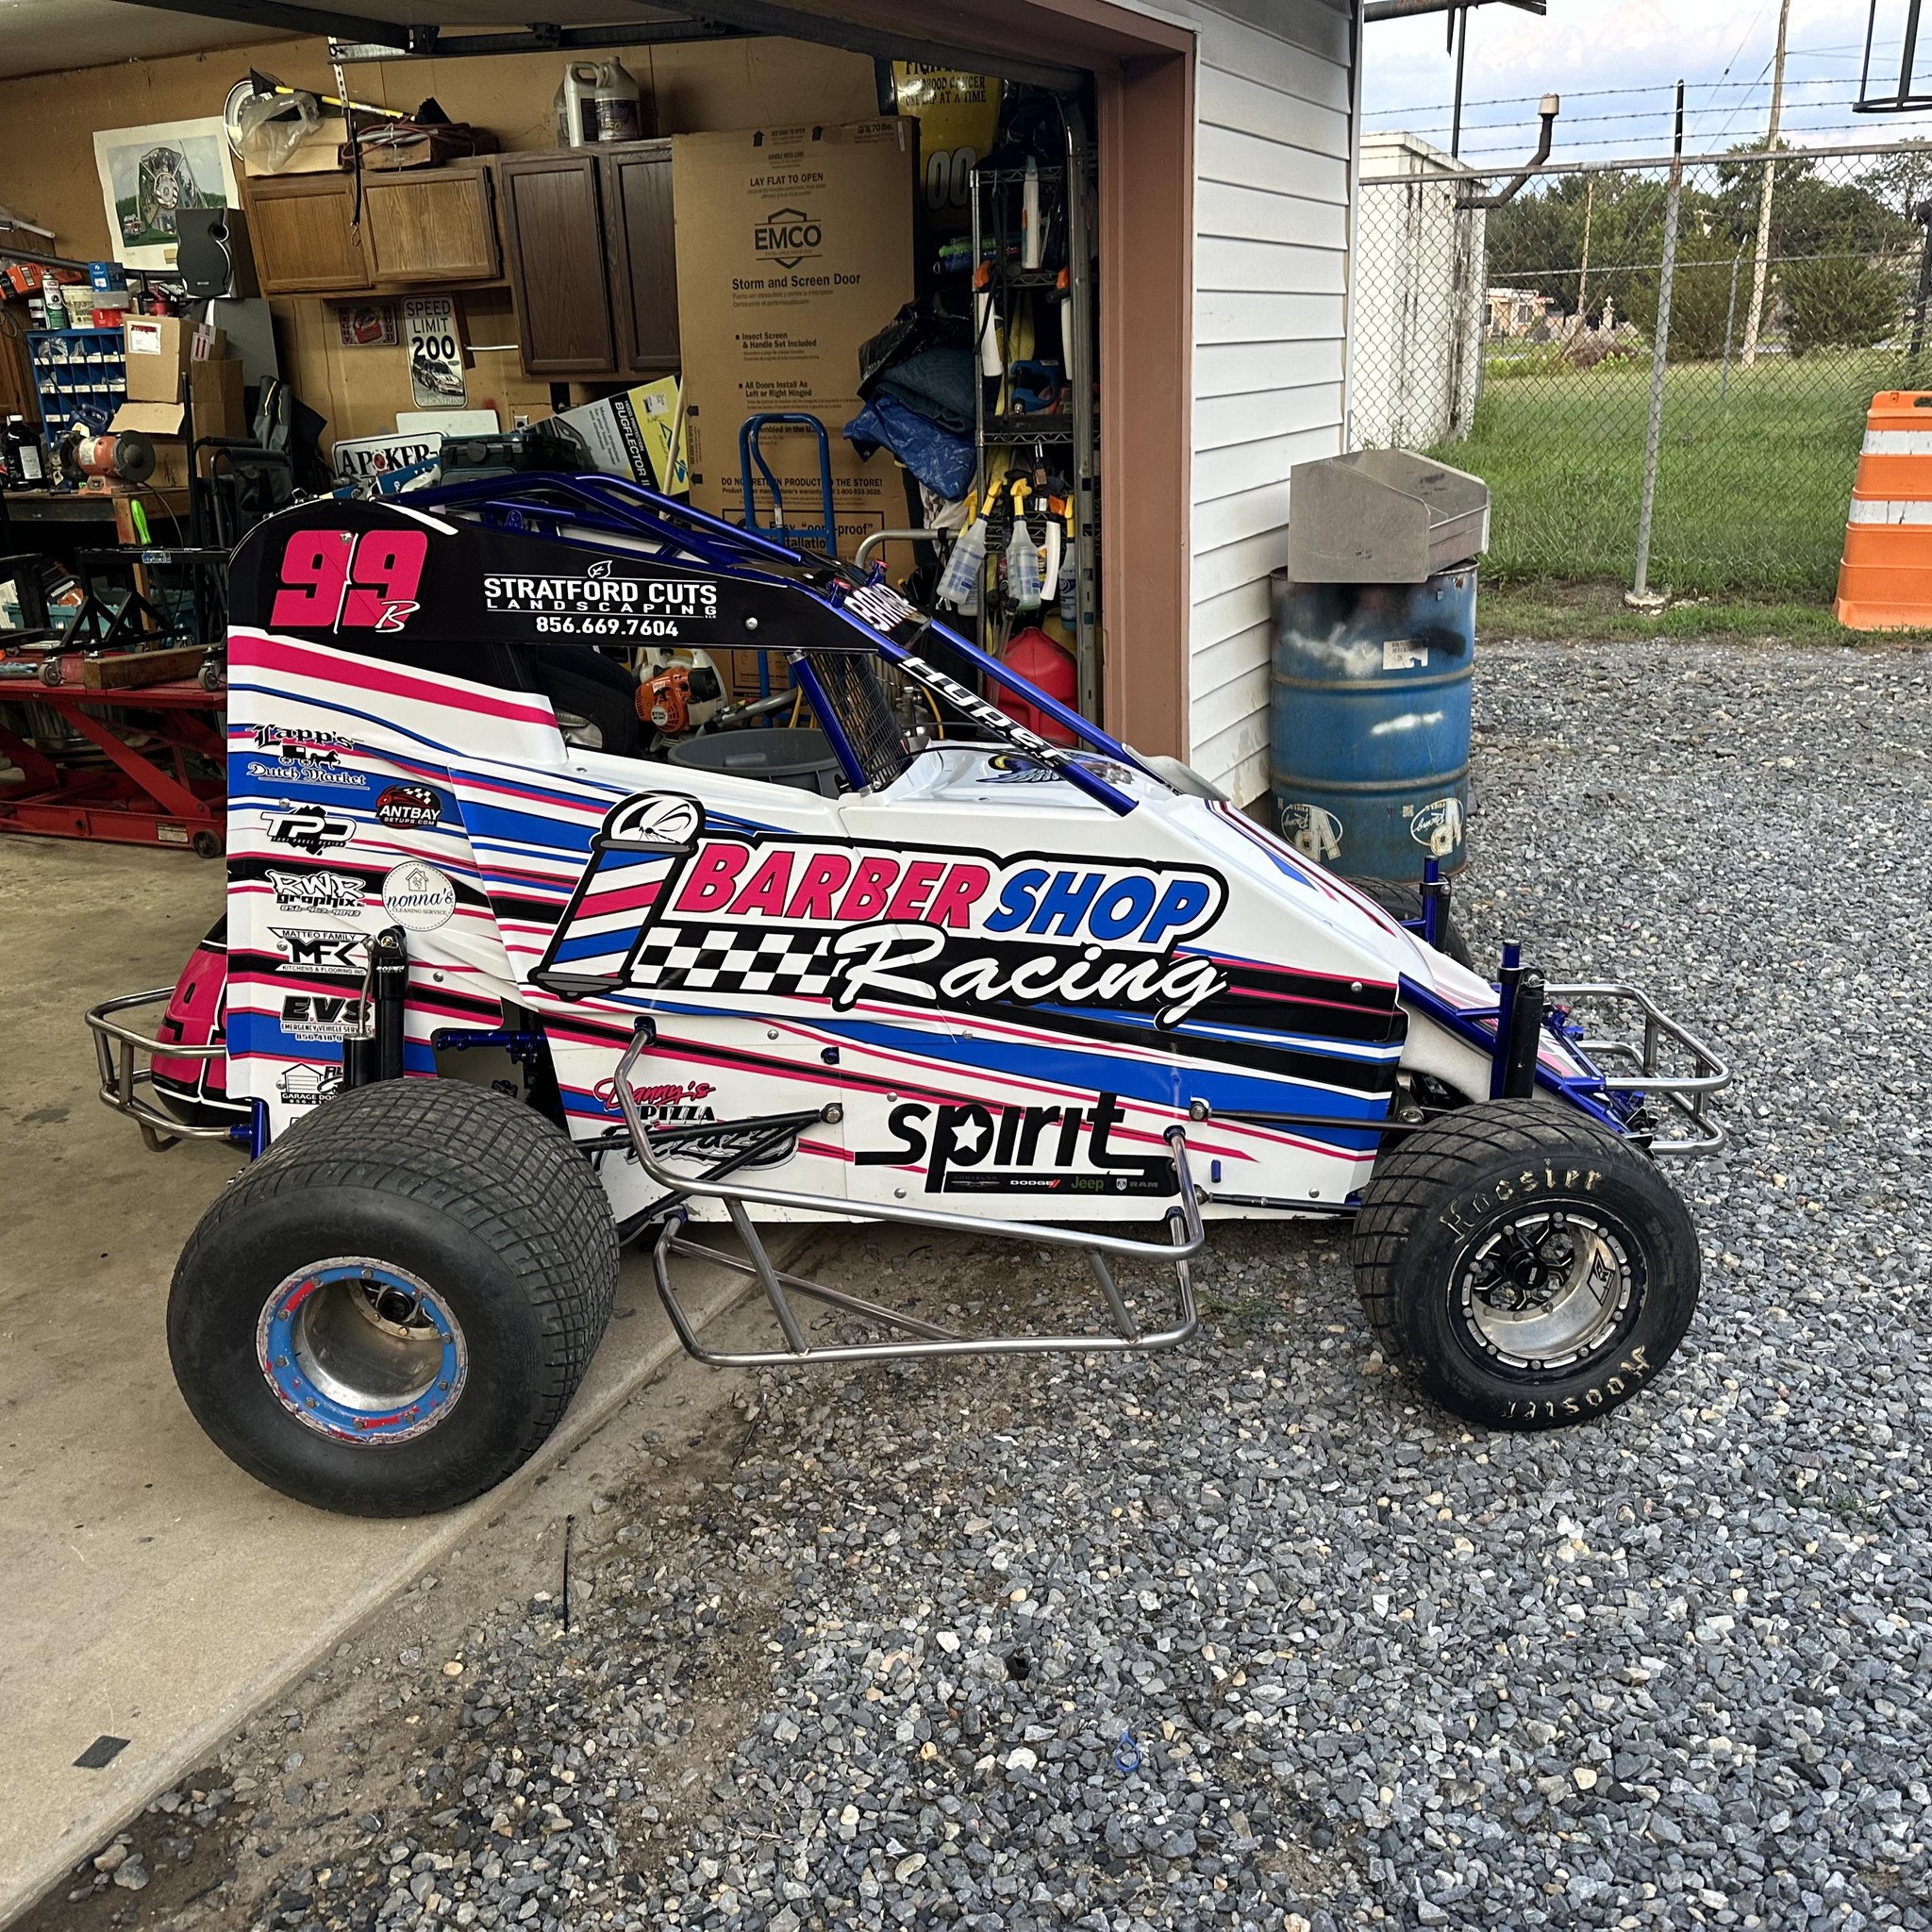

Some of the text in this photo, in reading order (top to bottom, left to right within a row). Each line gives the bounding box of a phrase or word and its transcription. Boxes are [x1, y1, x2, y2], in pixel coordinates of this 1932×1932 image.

[940, 92, 951, 104] AT
[954, 92, 960, 104] A
[963, 91, 987, 103] TIME
[750, 172, 824, 188] LAY FLAT TO OPEN
[926, 146, 976, 210] 00
[755, 225, 822, 251] EMCO
[732, 273, 861, 291] Storm and Screen Door
[407, 300, 451, 317] SPEED
[413, 318, 448, 333] LIMIT
[742, 331, 788, 341] Insect Screen
[750, 341, 772, 349] Handle
[774, 340, 786, 348] Set
[788, 340, 817, 348] Included
[412, 335, 455, 360] 200
[744, 381, 755, 390] All
[769, 390, 787, 399] Right
[788, 389, 812, 398] Hinged
[614, 402, 647, 476] BUGFLECTOR
[722, 477, 732, 486] DO
[753, 478, 782, 487] RETN
[784, 478, 821, 487] PRODUCT
[854, 477, 883, 487] STORE!
[769, 521, 796, 532] Esy
[270, 530, 428, 626] 99
[483, 577, 717, 605] STRATFORD CUTS
[487, 598, 717, 616] LANDSCAPING
[375, 600, 421, 633] B
[536, 616, 679, 638] 856.669.7604
[253, 724, 355, 751] Lapp's
[247, 762, 367, 786] Dutch Market
[378, 804, 441, 822] ANTBAY
[1416, 809, 1446, 832] Racing
[265, 869, 367, 898] RWR
[674, 842, 1210, 941] BARBER SHOP
[275, 893, 358, 908] graphix
[387, 888, 453, 909] nonna's
[391, 907, 423, 915] CLEANING
[282, 929, 356, 941] MATTEO FAMILY
[285, 938, 362, 966] MFK
[321, 966, 353, 974] FLOORING
[838, 923, 1227, 1026] Racing
[281, 1024, 317, 1032] EMERGENCY
[593, 1077, 717, 1110] Danny's
[640, 1105, 717, 1122] PIZZA
[854, 1091, 1177, 1194] spirit
[1071, 1175, 1105, 1191] Jeep
[1130, 1180, 1158, 1189] RAM
